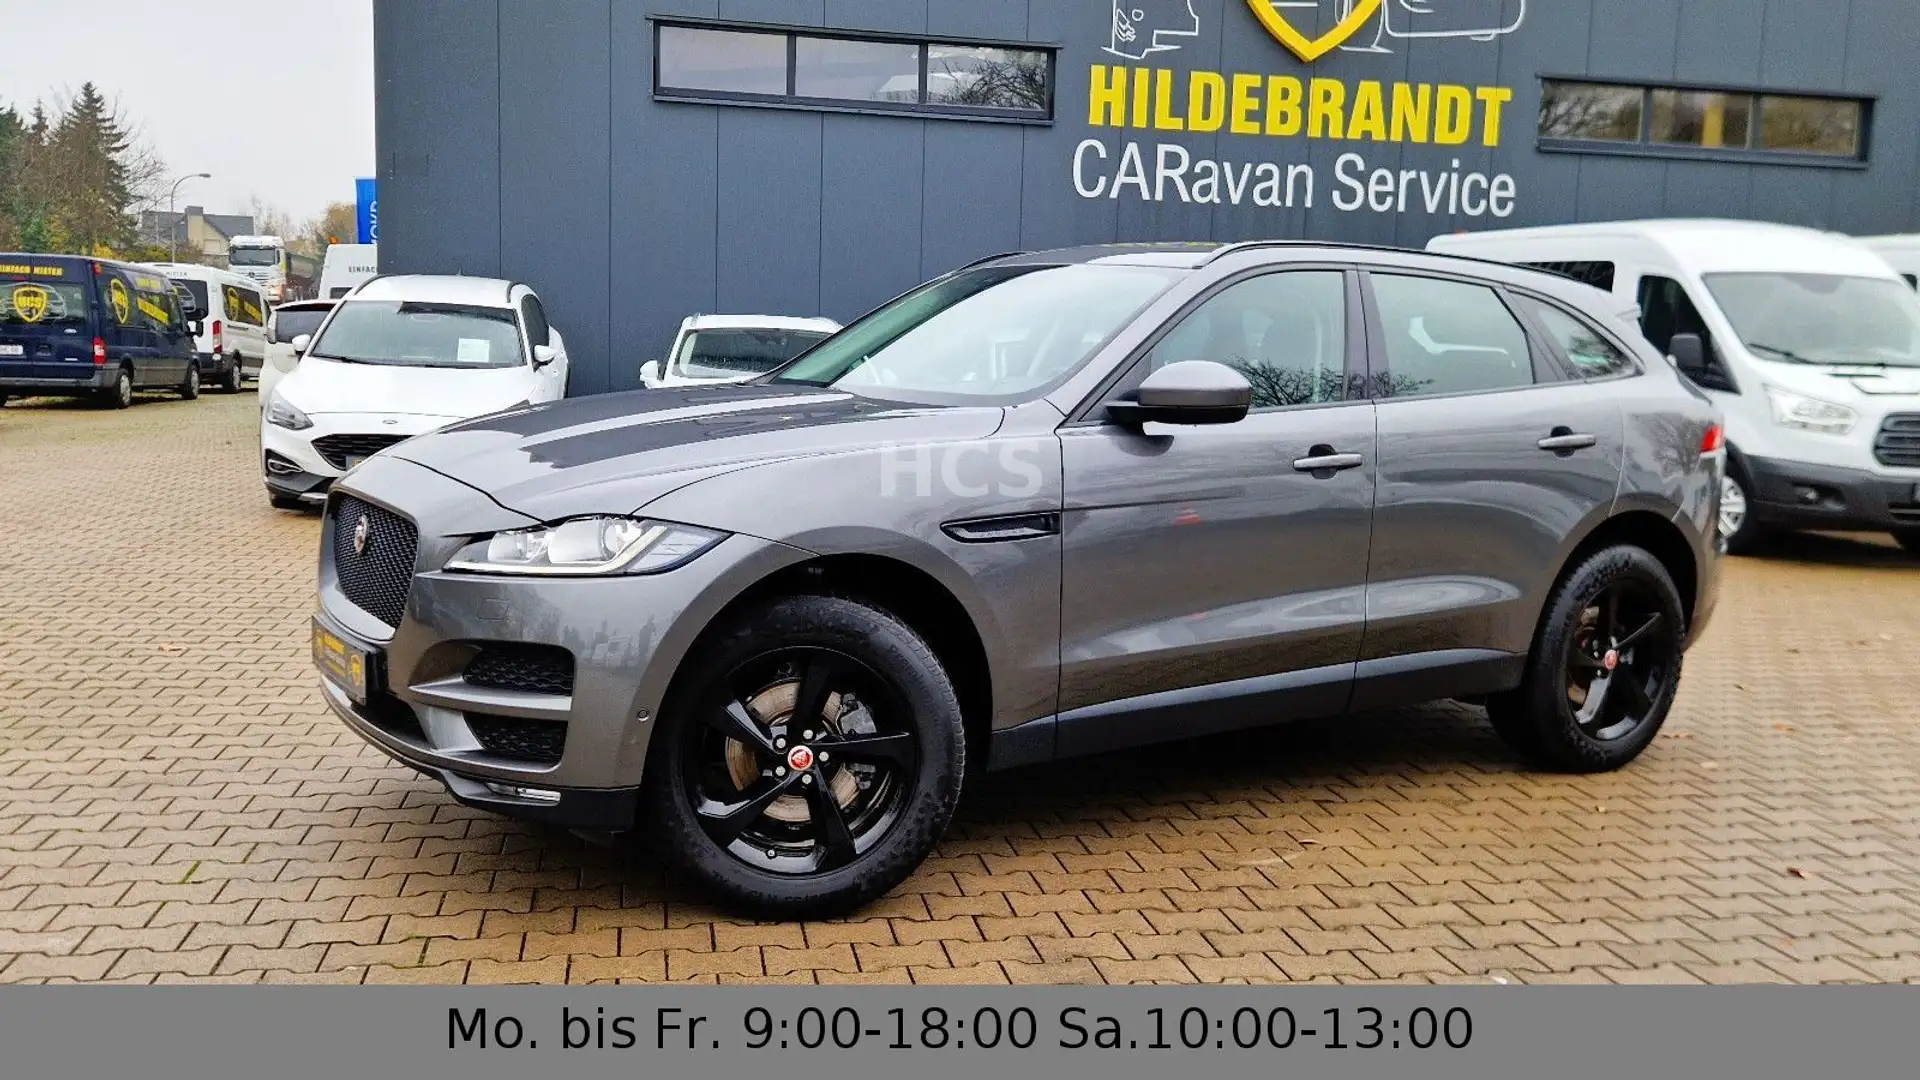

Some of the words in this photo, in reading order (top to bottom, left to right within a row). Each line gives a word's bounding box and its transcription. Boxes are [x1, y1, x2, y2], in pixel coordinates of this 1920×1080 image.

[1088, 64, 1512, 147] HILDEBRANDT
[1072, 139, 1313, 208] CARavan
[1332, 153, 1516, 217] Service
[348, 265, 376, 274] EINFAC
